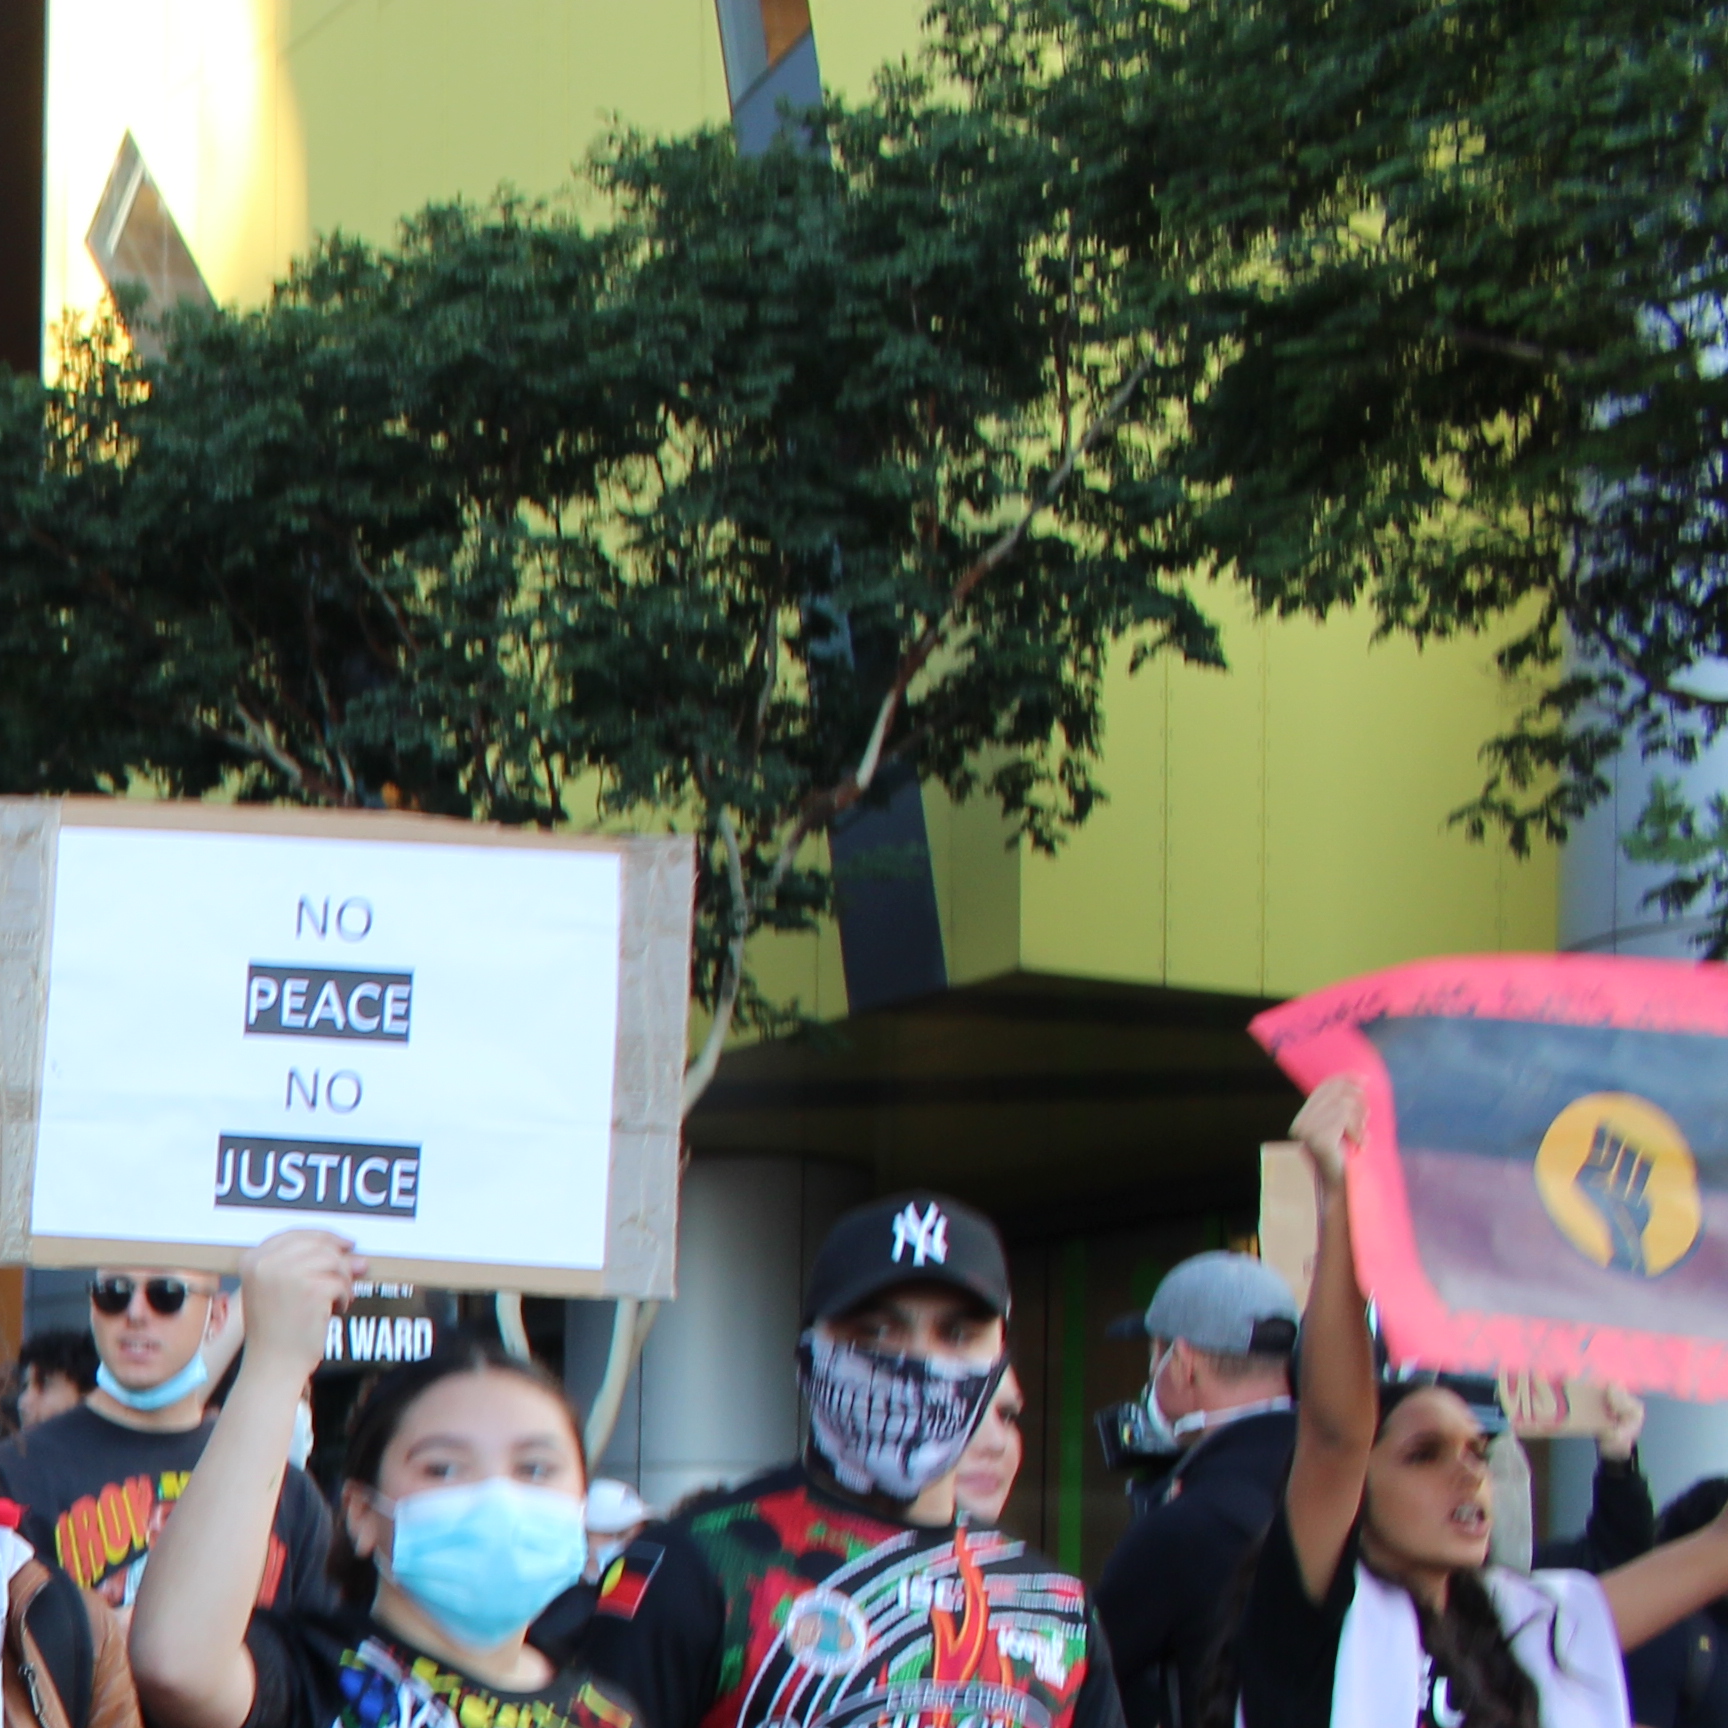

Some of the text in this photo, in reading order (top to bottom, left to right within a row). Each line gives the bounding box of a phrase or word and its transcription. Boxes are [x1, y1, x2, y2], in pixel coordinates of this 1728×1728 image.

[295, 894, 374, 941] NO
[247, 976, 412, 1036] PEACE
[285, 1068, 363, 1115] NO
[216, 1149, 418, 1210] JUSTICE
[348, 1316, 433, 1362] WARD
